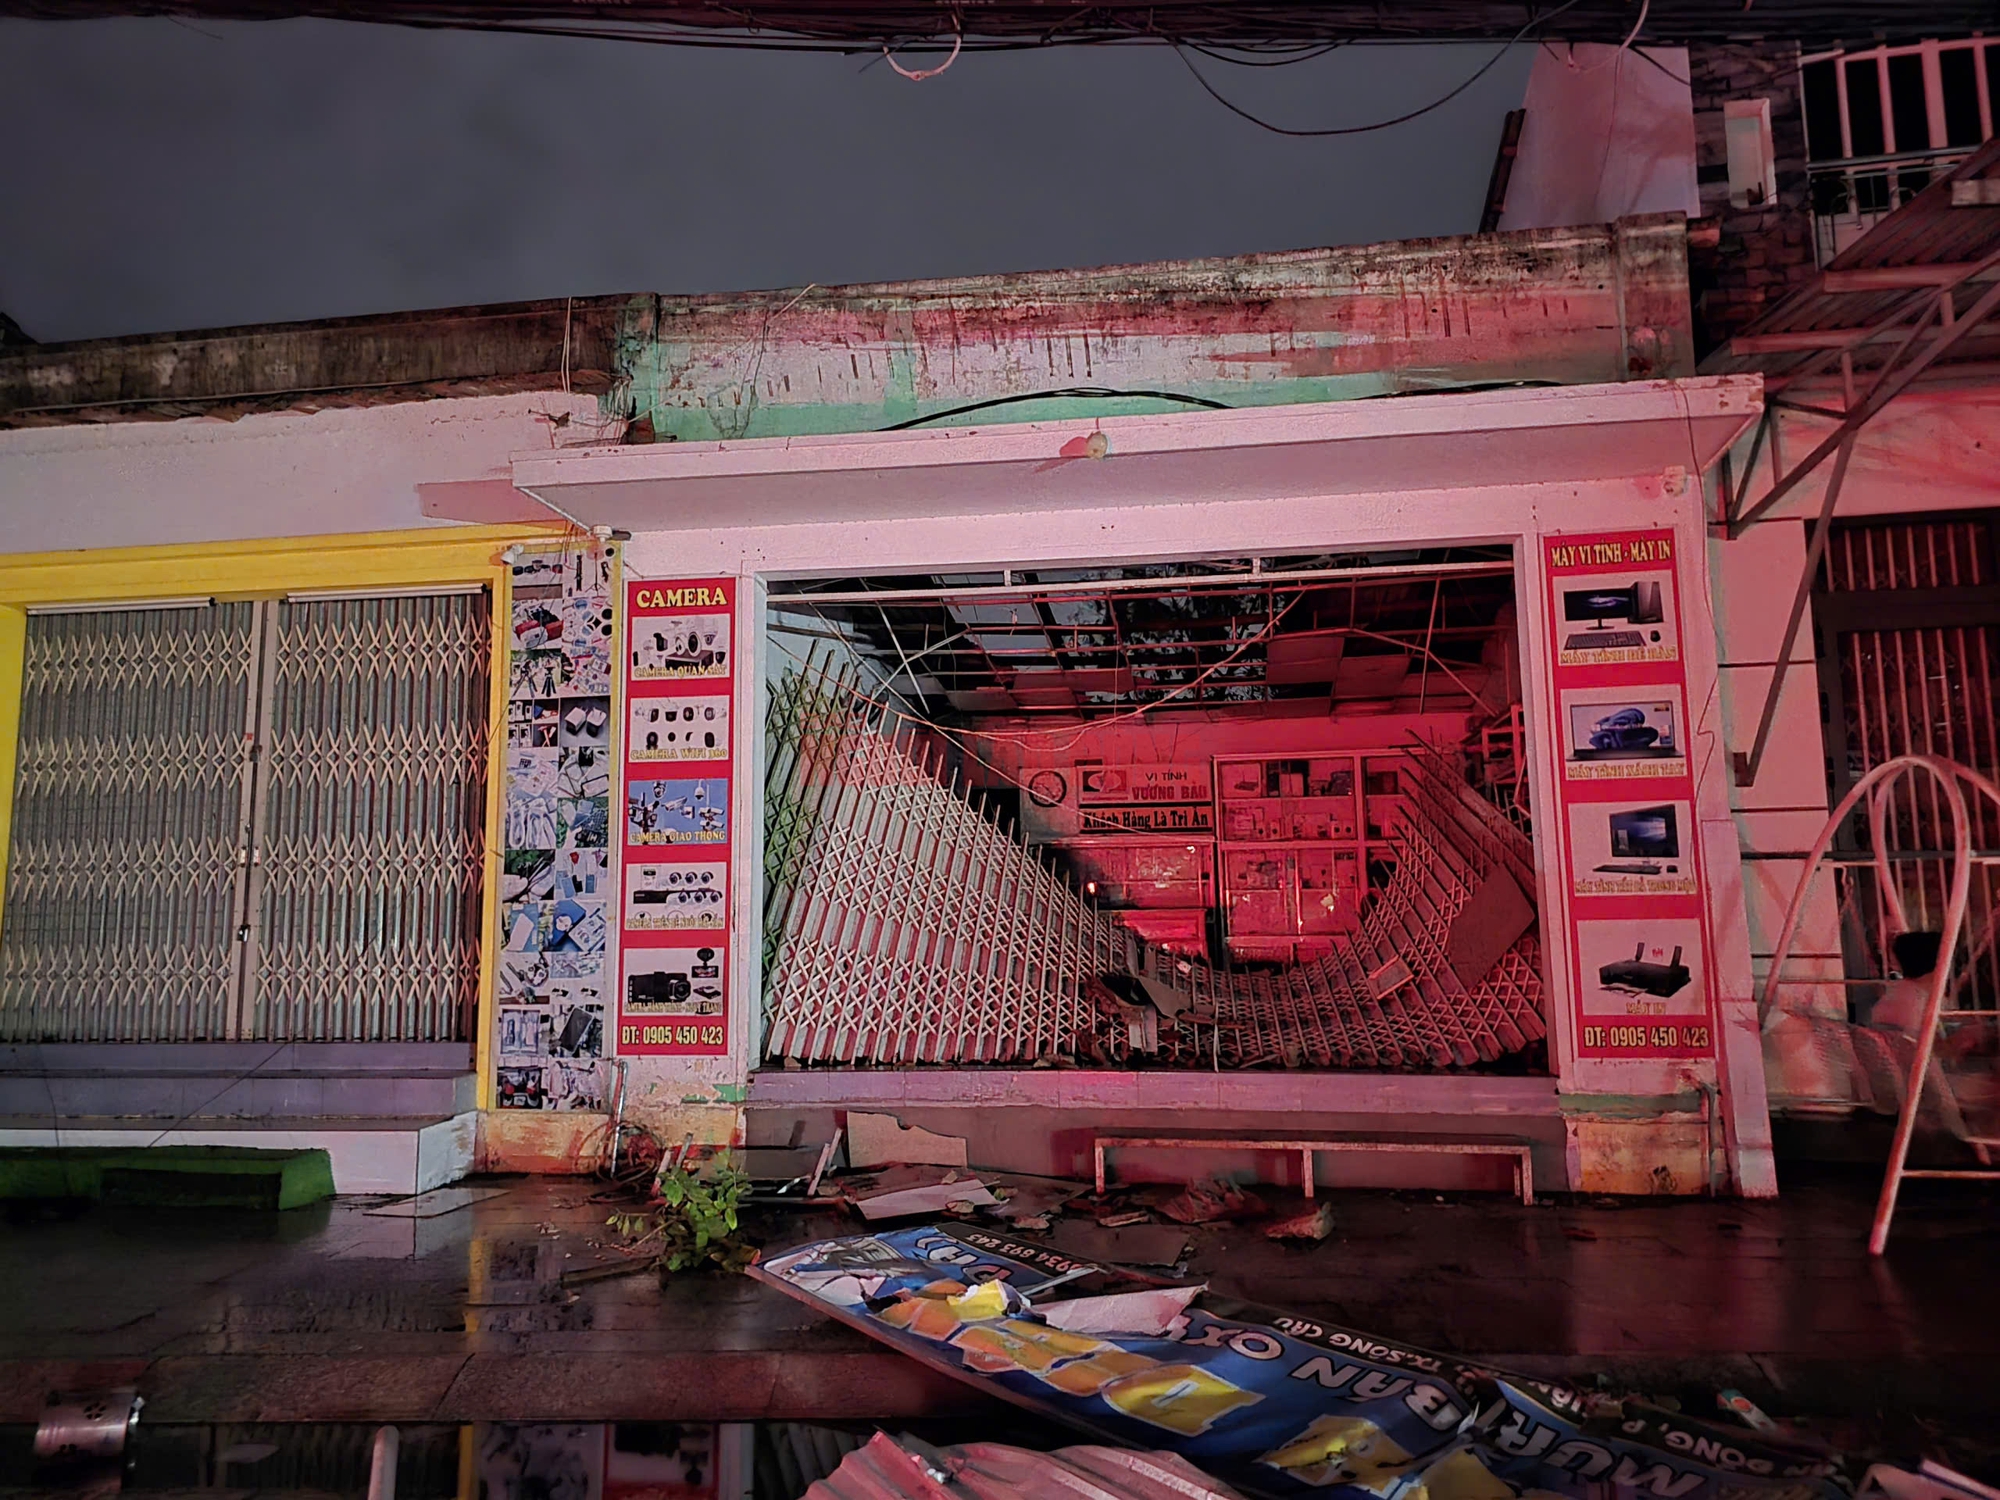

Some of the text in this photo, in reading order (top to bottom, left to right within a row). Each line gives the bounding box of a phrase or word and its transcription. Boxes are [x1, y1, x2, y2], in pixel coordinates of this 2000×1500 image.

[1551, 541, 1576, 567] MÁY
[1578, 545, 1592, 565] VI
[1593, 539, 1623, 564] TÍNH
[1630, 536, 1656, 562] MÁY
[1658, 539, 1671, 560] IN
[636, 587, 727, 608] CAMERA
[1560, 648, 1589, 664] MÁY
[1591, 646, 1625, 662] TÍNH
[634, 666, 675, 678] CAMERA
[677, 664, 705, 678] QUAN
[630, 748, 677, 760] CAMERA
[681, 747, 706, 759] WIFI
[1162, 769, 1187, 780] TÍNH
[1567, 763, 1593, 778] MÁY
[1595, 762, 1625, 777] TÍNH
[1122, 810, 1151, 829] Hàng
[1154, 810, 1167, 827] Là
[1170, 810, 1188, 827] Tri
[669, 832, 692, 841] GIAO
[622, 1025, 723, 1044] ĐT: 0905 450 423
[1584, 1026, 1709, 1046] ĐT: 0905 450 423
